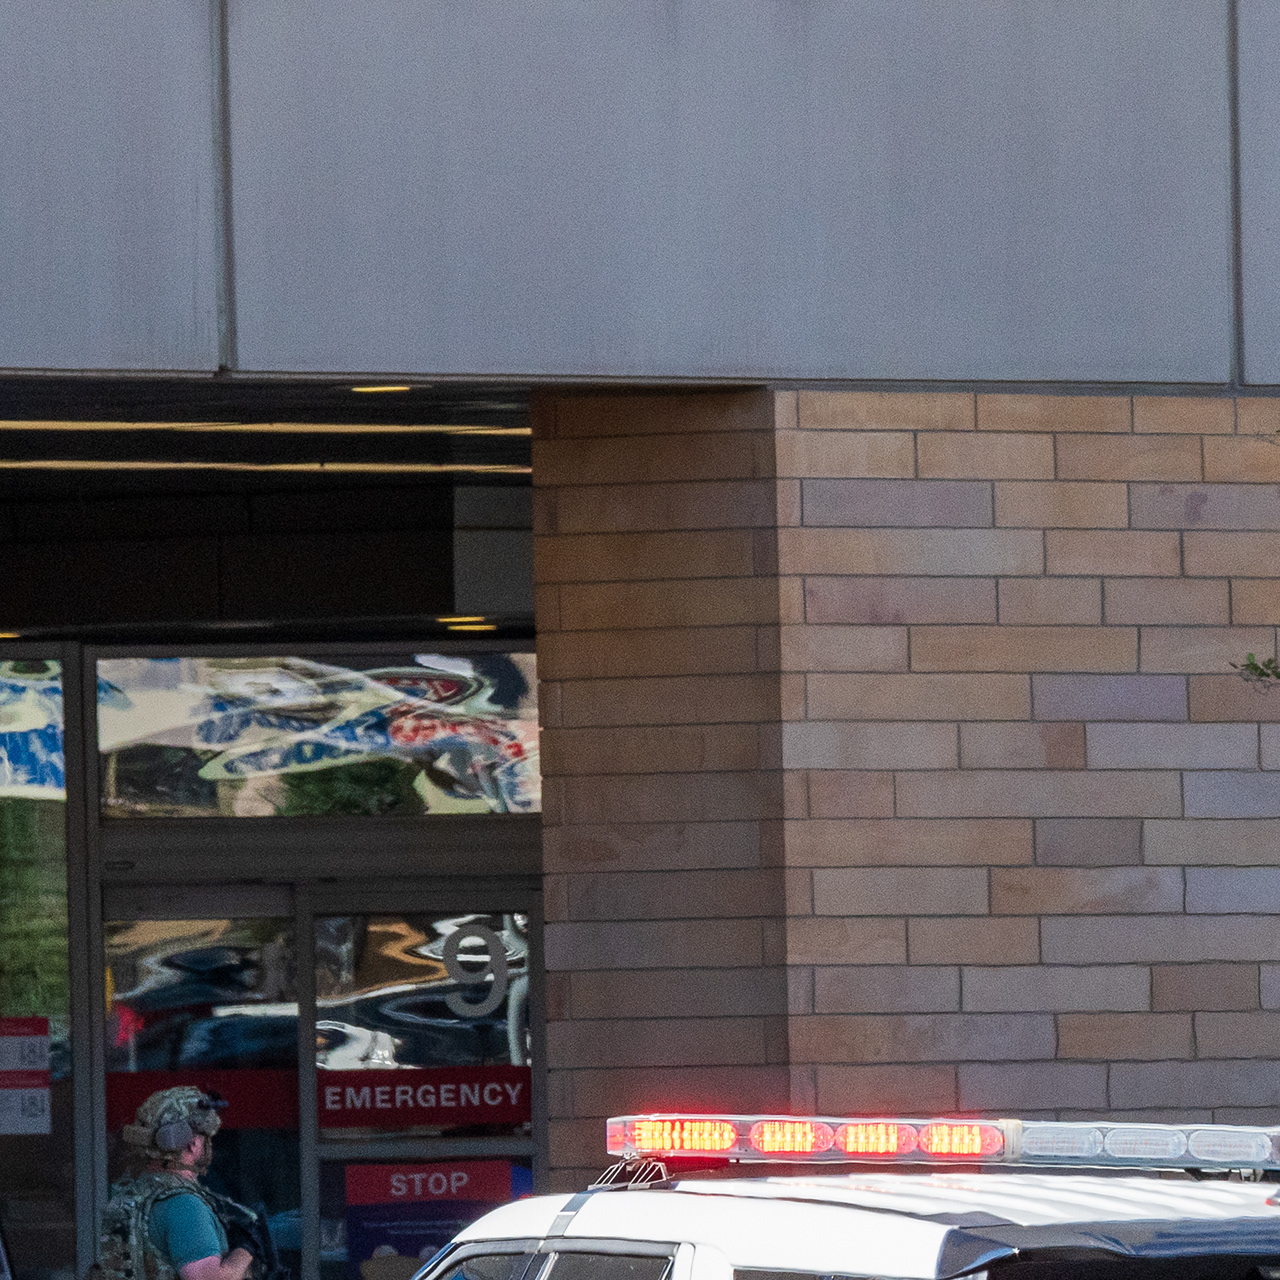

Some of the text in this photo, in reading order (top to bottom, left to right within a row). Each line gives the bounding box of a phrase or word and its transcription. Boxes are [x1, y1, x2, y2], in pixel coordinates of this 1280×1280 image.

[443, 924, 507, 1018] 9
[324, 1082, 523, 1110] EMERGENCY
[390, 1171, 469, 1197] STOP
